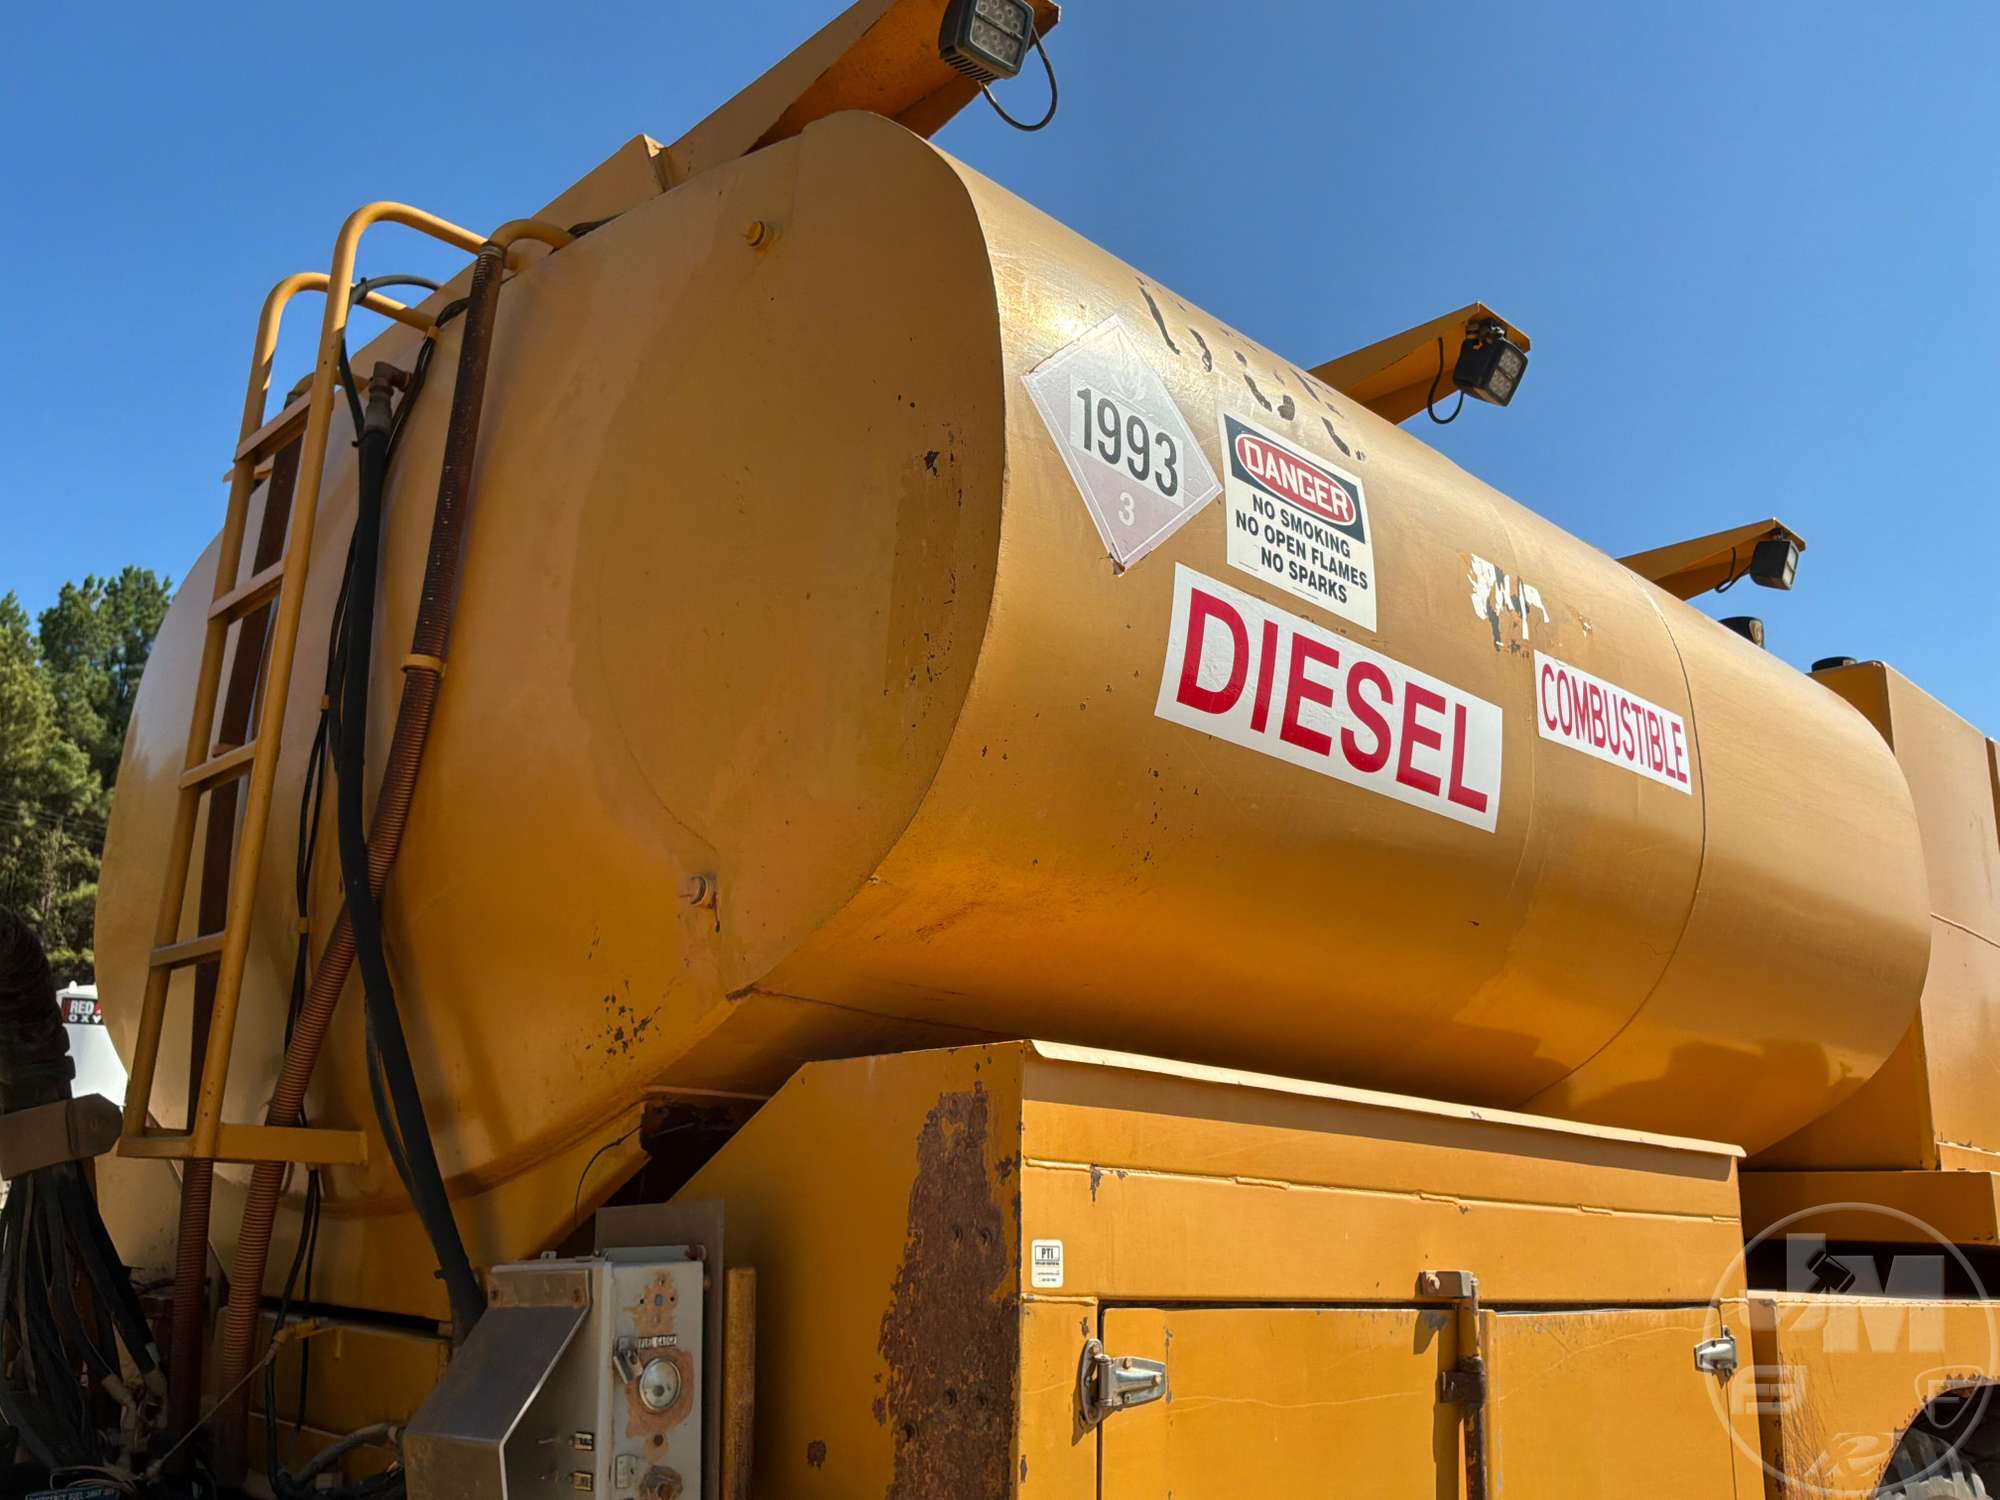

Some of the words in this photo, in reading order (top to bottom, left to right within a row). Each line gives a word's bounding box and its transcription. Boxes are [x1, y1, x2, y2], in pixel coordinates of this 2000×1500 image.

[1076, 387, 1178, 497] 1993
[1118, 492, 1136, 526] 3
[1243, 438, 1350, 521] DANGER
[1235, 509, 1259, 536] NO
[1264, 525, 1306, 560] OPEN
[1311, 547, 1368, 590] FLAMES
[1252, 494, 1275, 520] NO
[1280, 508, 1351, 558] SMOKING
[1261, 547, 1284, 573] NO
[1289, 560, 1347, 603] SPARKS
[1175, 586, 1489, 814] DIESEL
[1541, 663, 1688, 784] COMBUSTIBLE
[70, 1000, 95, 1015] RED
[1041, 1248, 1053, 1259] PTI
